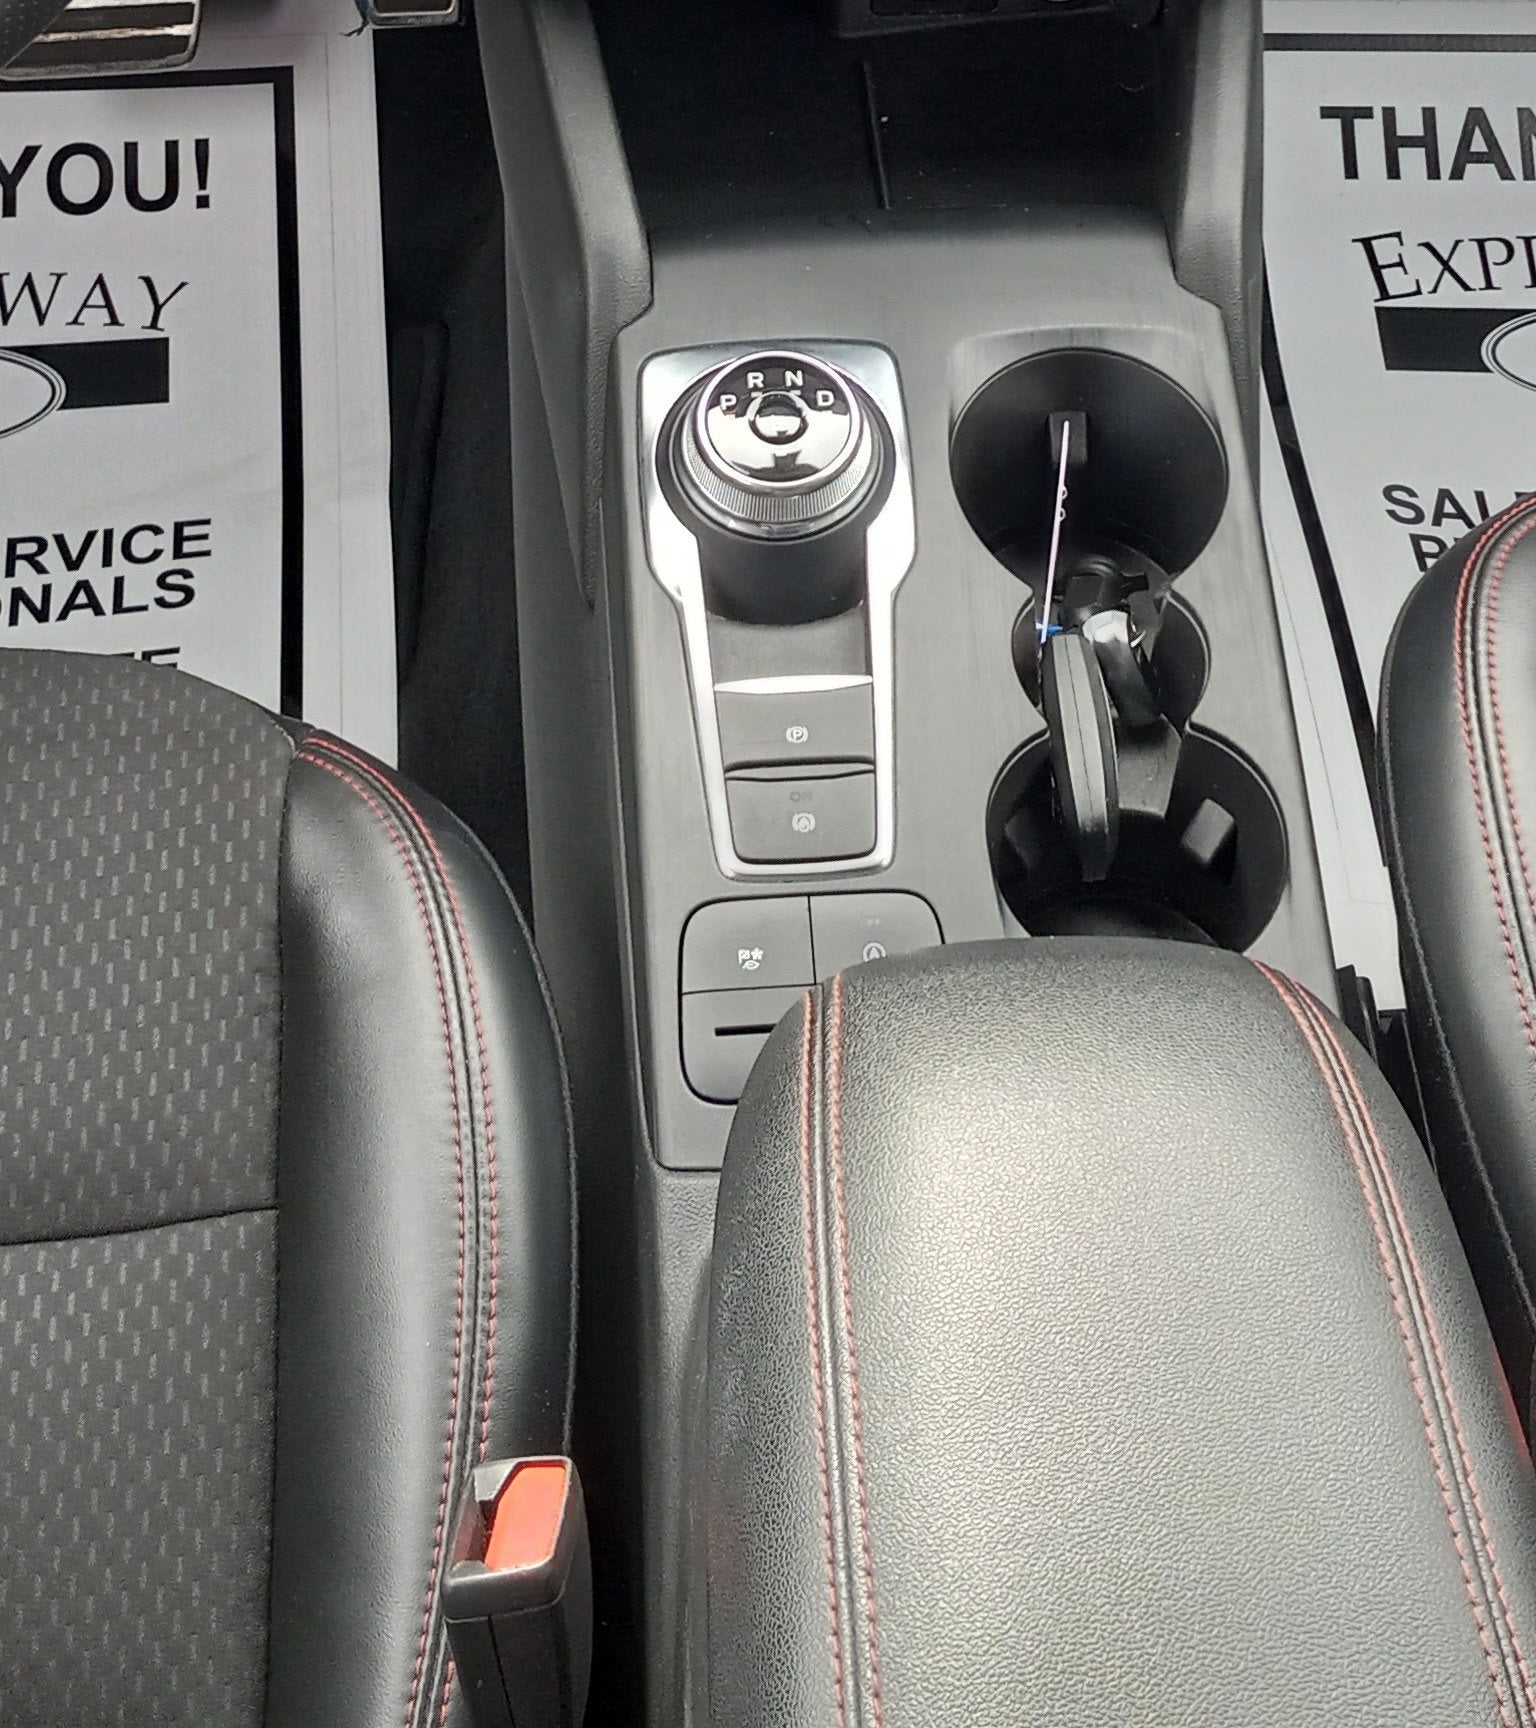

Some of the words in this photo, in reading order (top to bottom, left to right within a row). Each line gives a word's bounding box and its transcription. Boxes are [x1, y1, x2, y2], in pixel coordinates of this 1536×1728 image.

[746, 371, 765, 390] R
[785, 369, 804, 388] N
[719, 394, 738, 412] P
[816, 390, 835, 408] D
